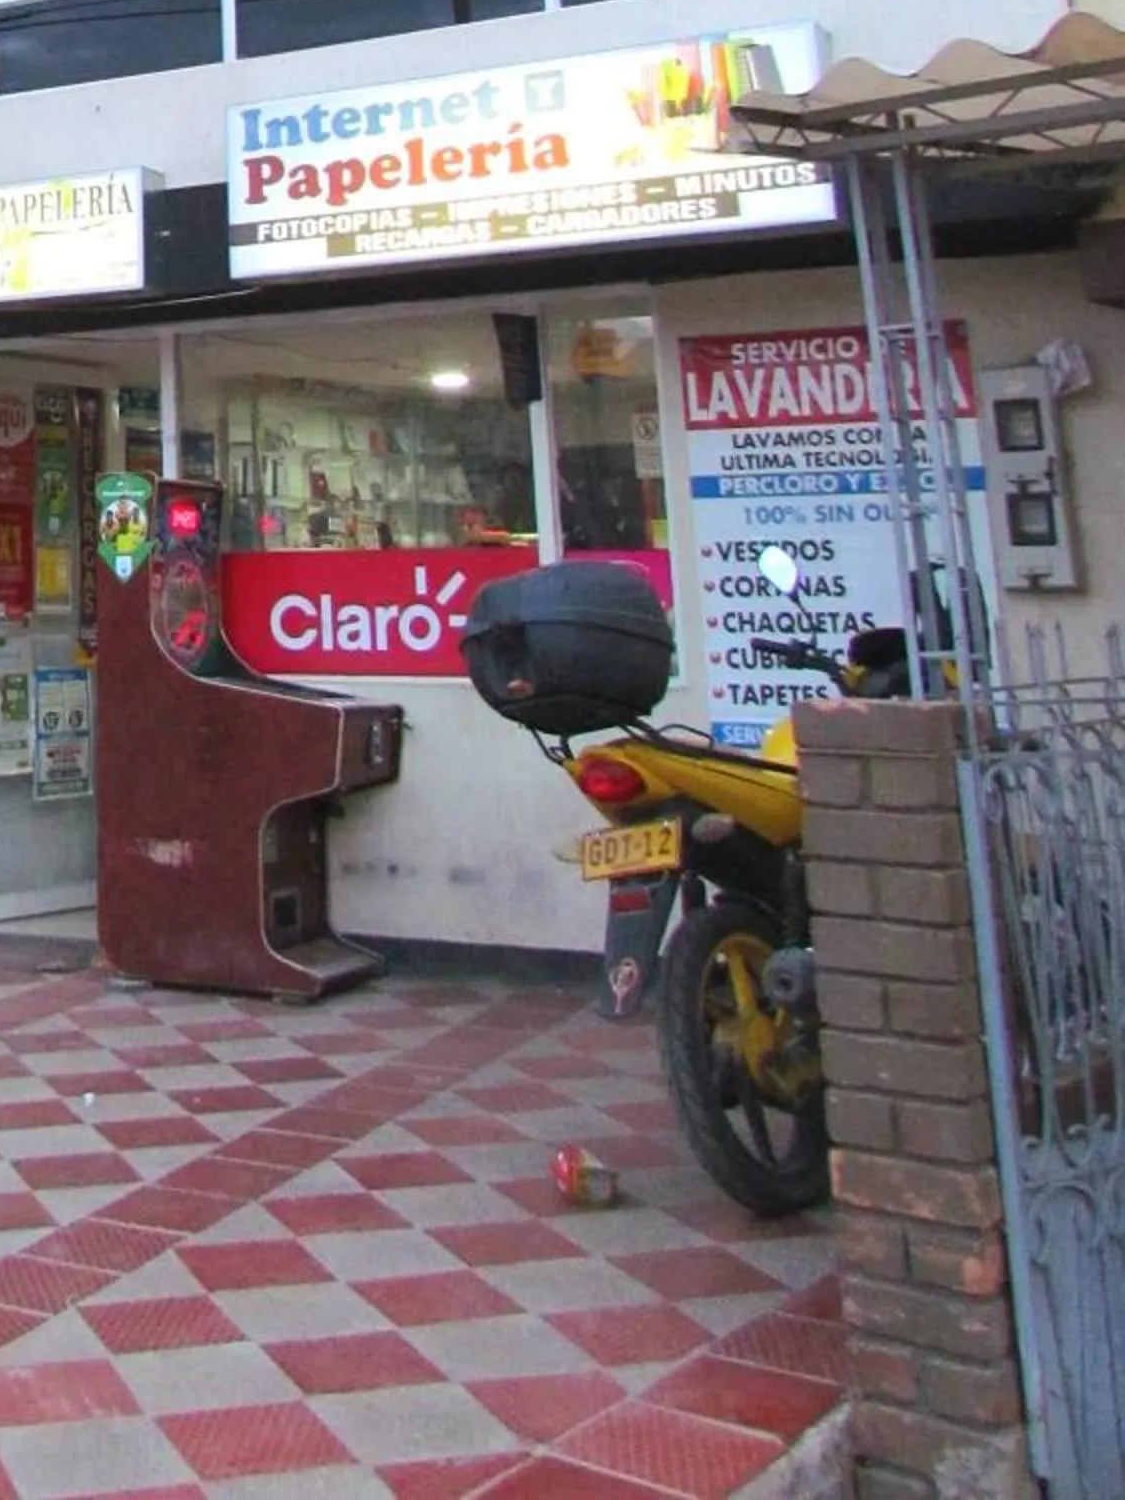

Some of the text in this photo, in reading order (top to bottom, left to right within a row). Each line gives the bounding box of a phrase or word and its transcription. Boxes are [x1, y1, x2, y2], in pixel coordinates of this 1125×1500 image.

[241, 78, 501, 151] Internet
[243, 122, 571, 207] Papelería
[256, 207, 412, 242] FOTOCOPIAS
[674, 161, 818, 198] MINUTOS
[354, 198, 719, 254] RECARGAS CARGADORES
[731, 335, 860, 364] SERVICIO
[685, 357, 971, 422] LAVANDA
[731, 430, 836, 449] LAVAMOS
[720, 453, 796, 471] ULTIMA
[718, 474, 838, 496] PERCLORO
[843, 474, 862, 493] Y
[744, 504, 807, 525] 100%
[816, 503, 856, 523] SIN
[715, 541, 836, 563] VESDOS
[719, 575, 848, 598] CORNAS
[270, 592, 441, 653] Claro
[723, 611, 876, 634] CHAQUETAS
[729, 683, 830, 706] TAPETES
